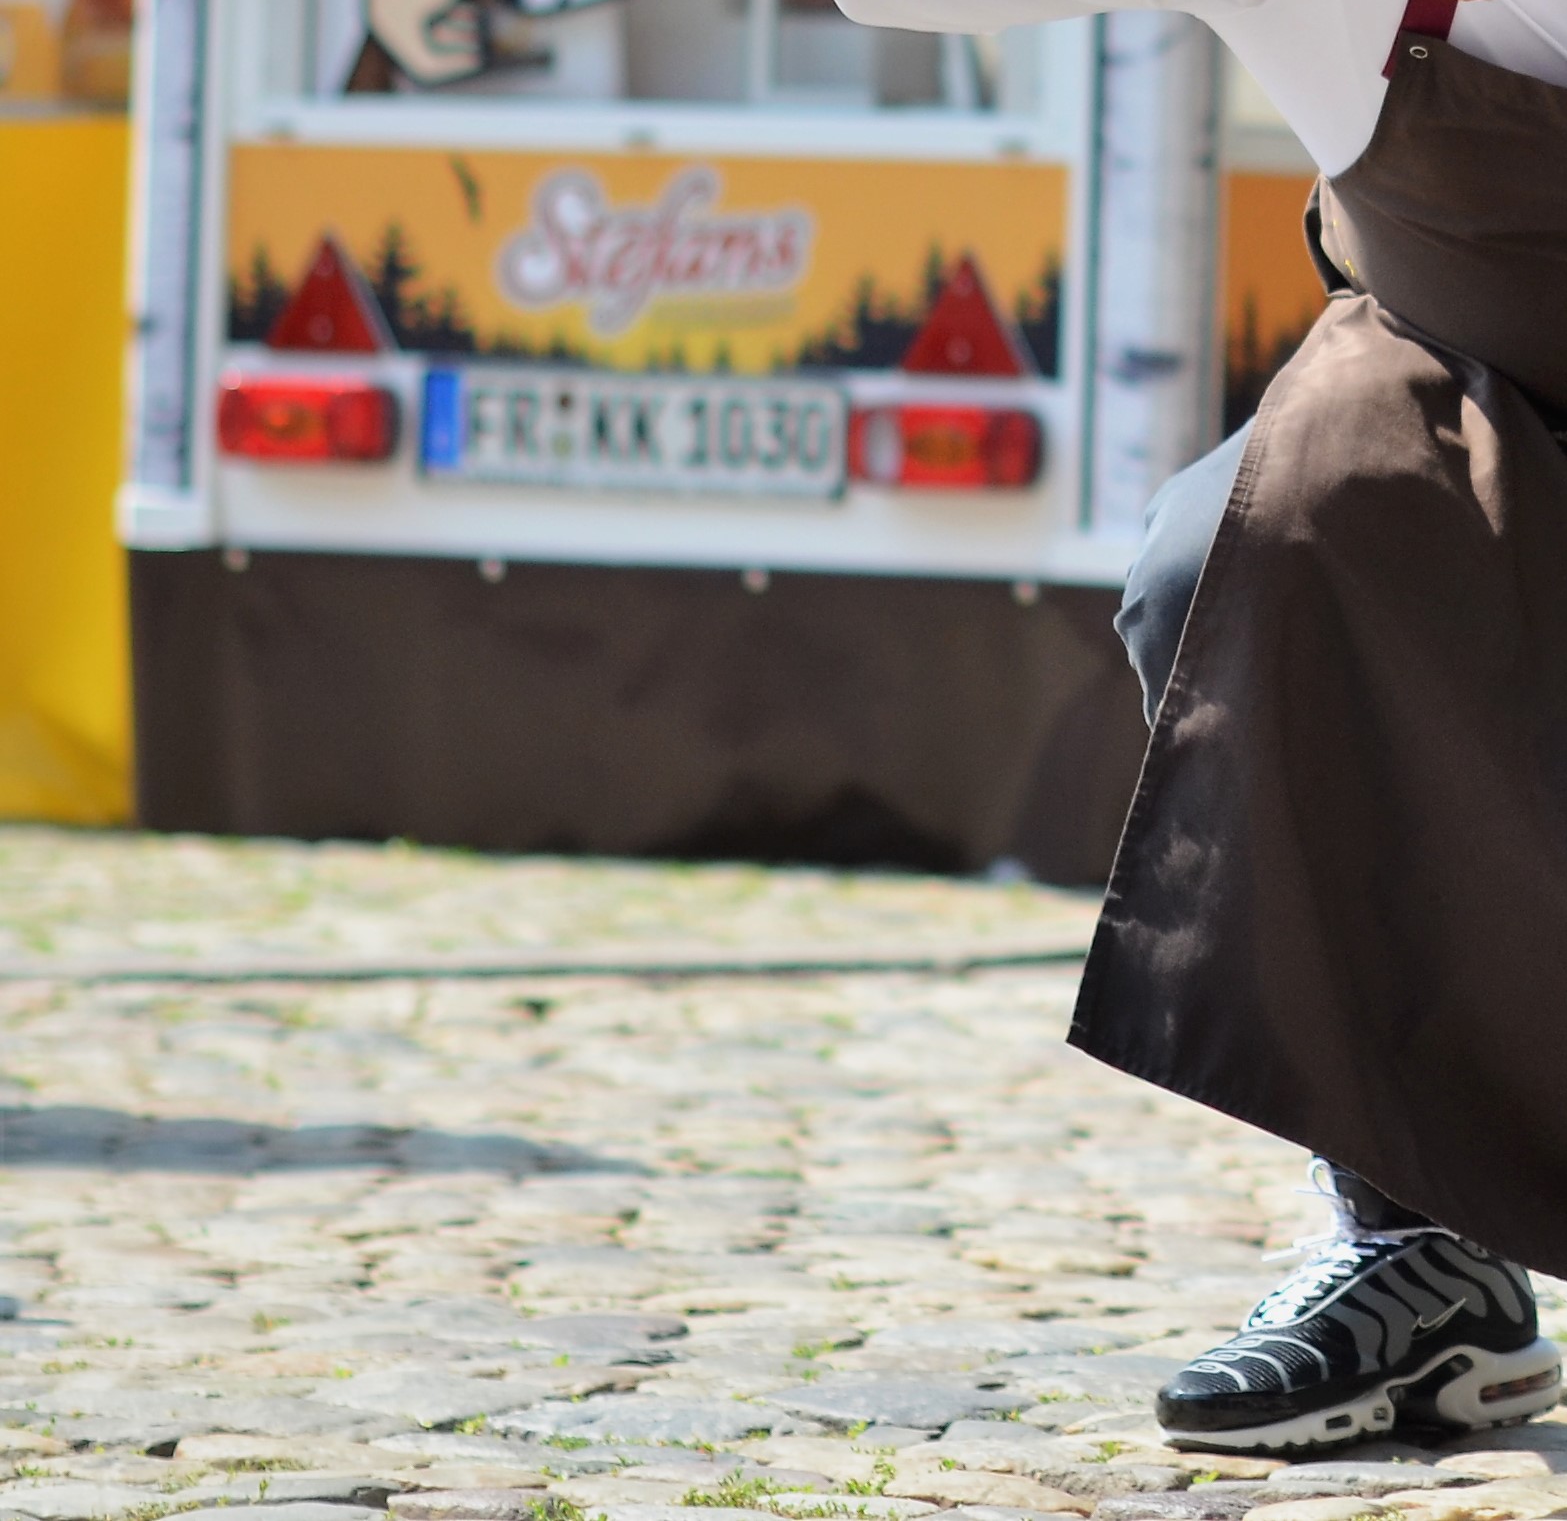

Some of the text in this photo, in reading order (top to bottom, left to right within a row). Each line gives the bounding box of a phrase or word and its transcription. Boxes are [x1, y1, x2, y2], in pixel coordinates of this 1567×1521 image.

[497, 166, 814, 336] Stefans
[468, 386, 541, 459] FR
[681, 396, 831, 470] 1030
